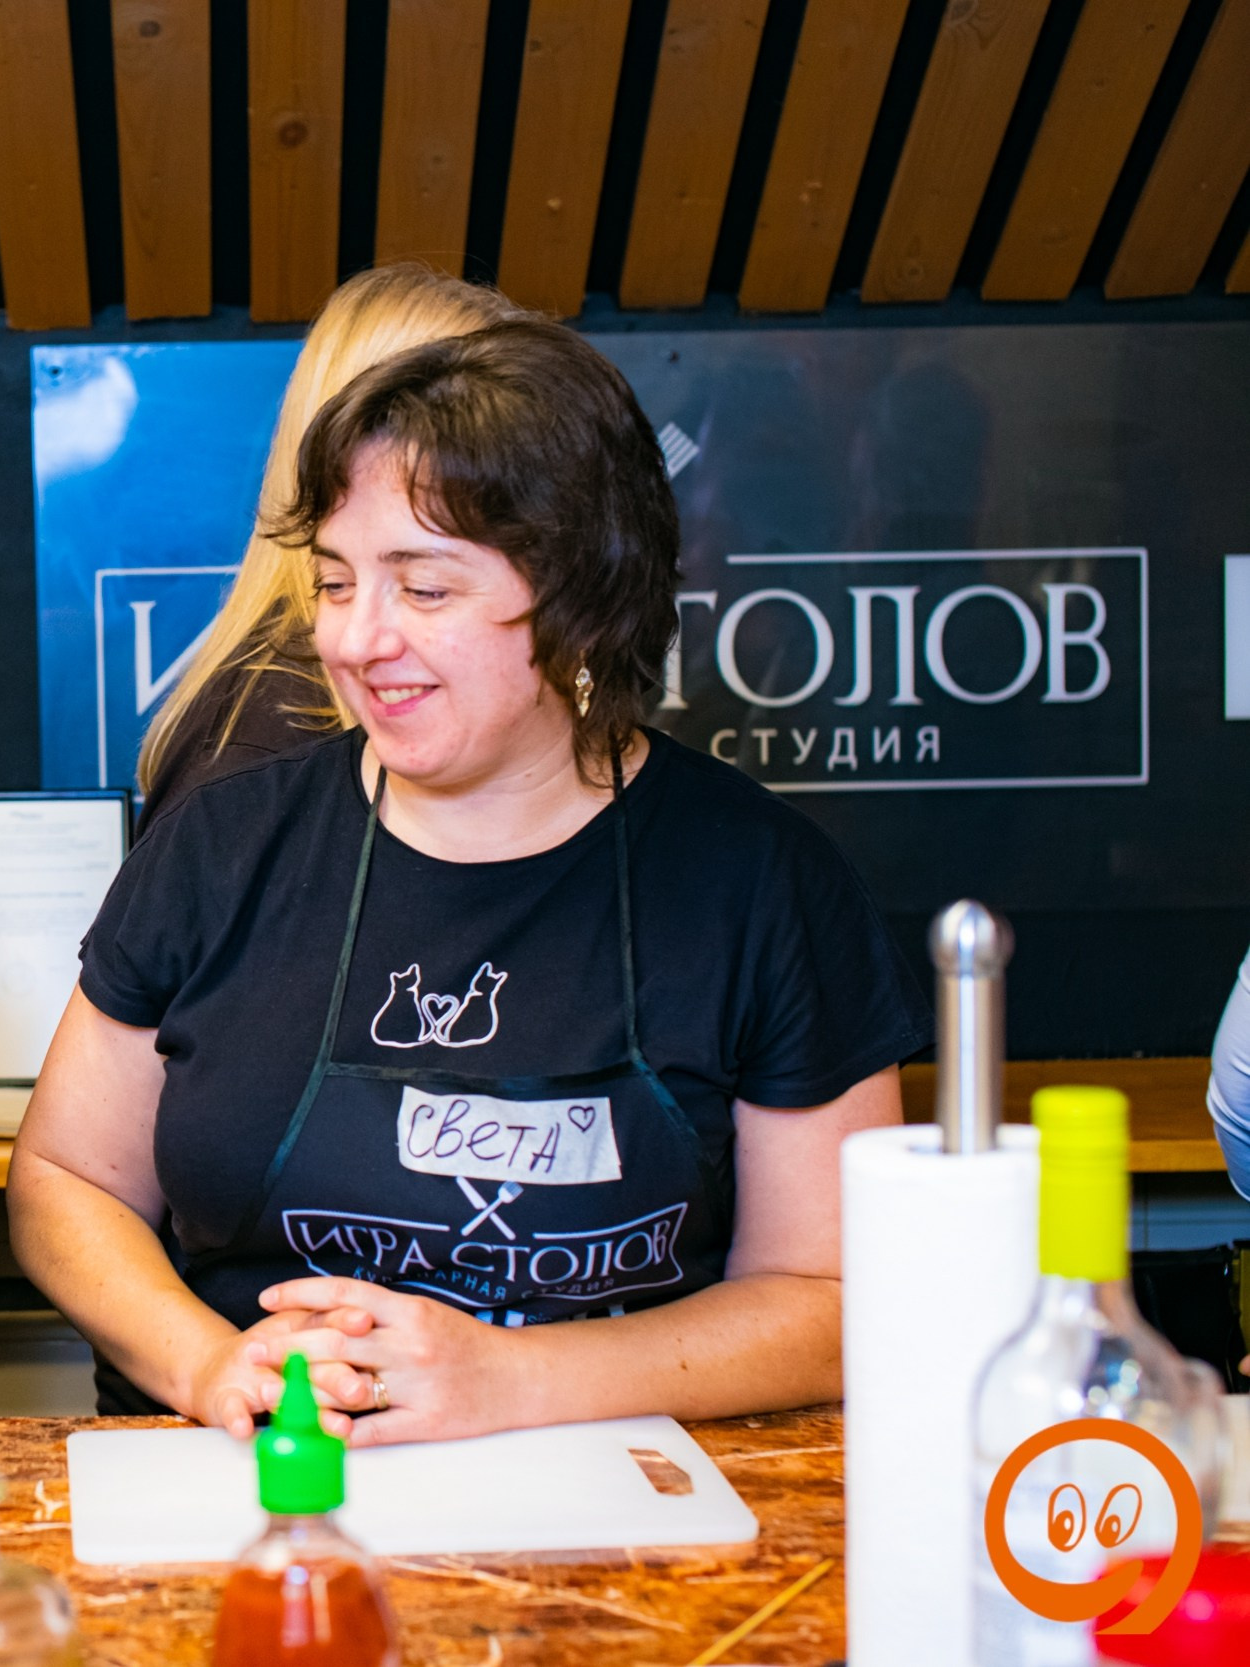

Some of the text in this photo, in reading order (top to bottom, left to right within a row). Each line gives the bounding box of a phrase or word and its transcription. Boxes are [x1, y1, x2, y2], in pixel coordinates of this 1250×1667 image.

[659, 583, 1112, 711] ТОЛОВ
[710, 725, 941, 771] СТУДИЯ
[299, 1219, 671, 1285] ИГРА СТОЛОВ
